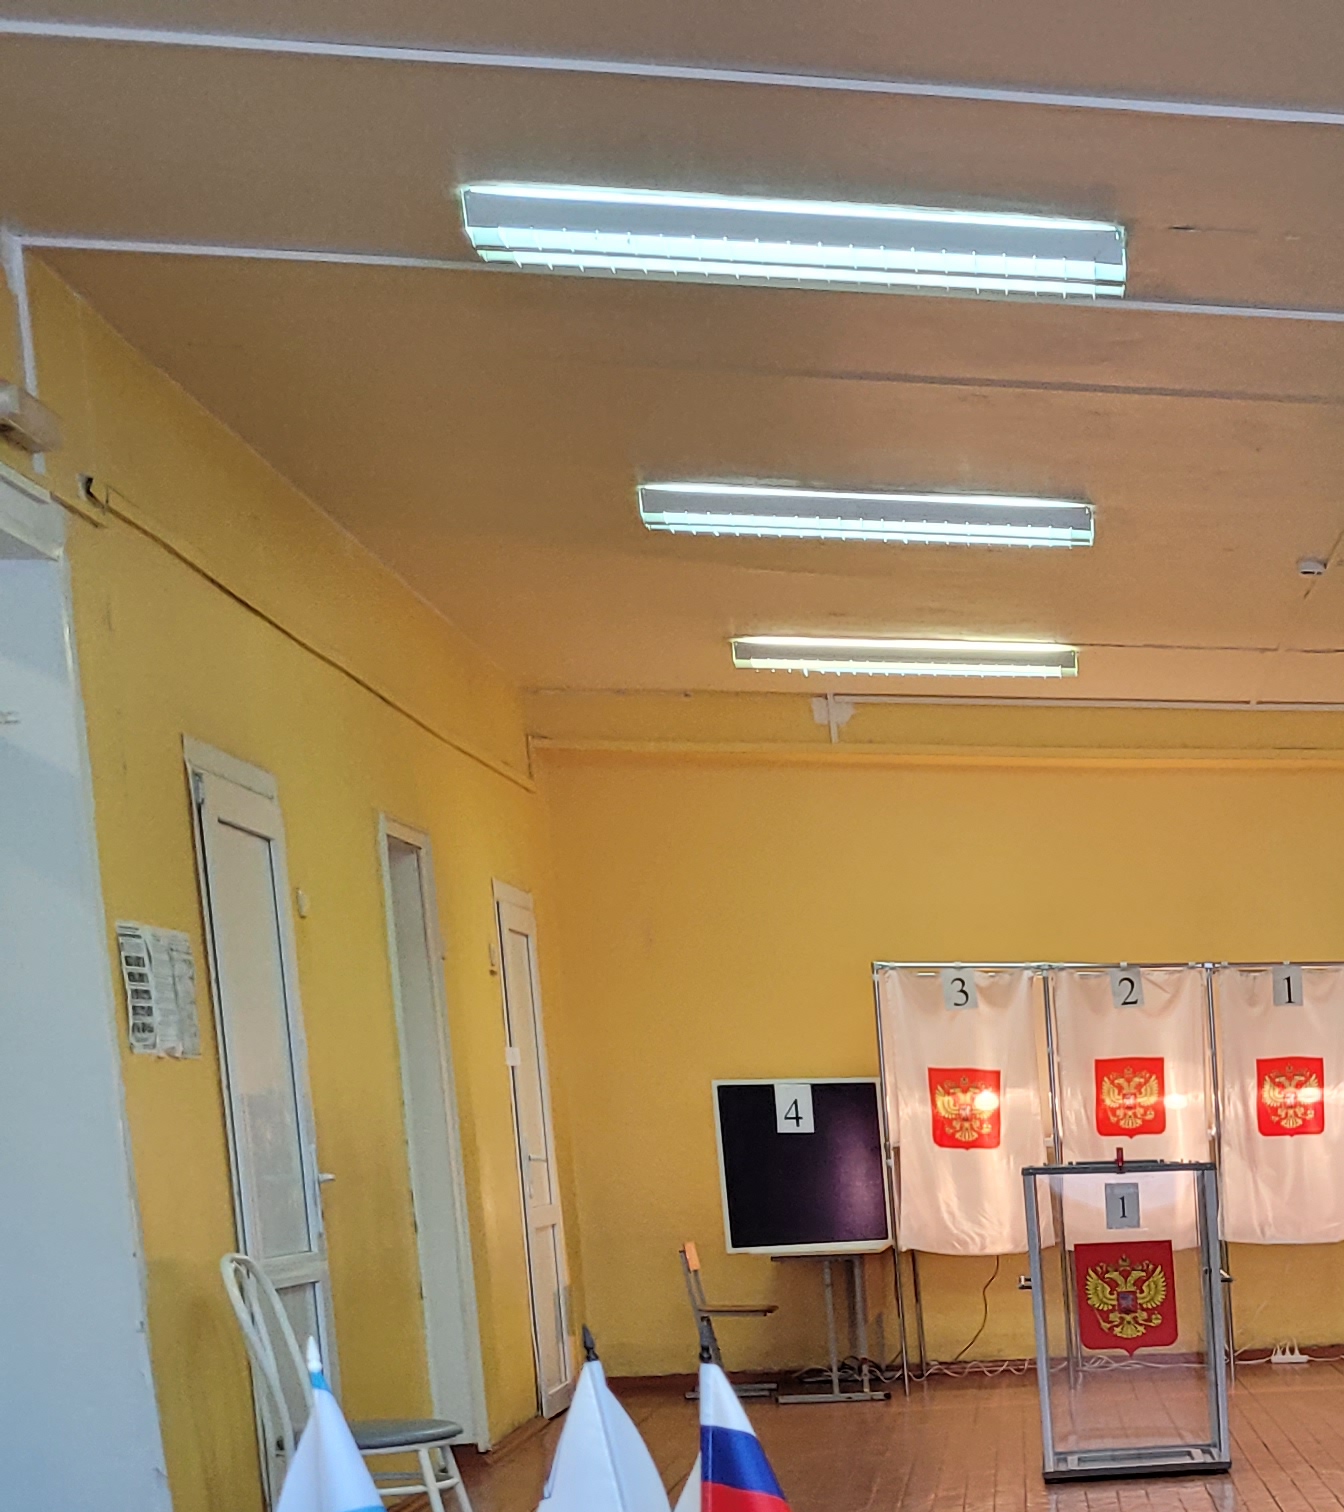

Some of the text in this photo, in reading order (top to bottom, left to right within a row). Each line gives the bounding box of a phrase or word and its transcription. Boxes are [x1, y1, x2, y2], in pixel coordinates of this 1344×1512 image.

[951, 977, 969, 1006] 3
[1118, 976, 1138, 1005] 2
[1283, 975, 1296, 1004] 1
[784, 1098, 803, 1128] 4
[1118, 1195, 1128, 1219] 1
